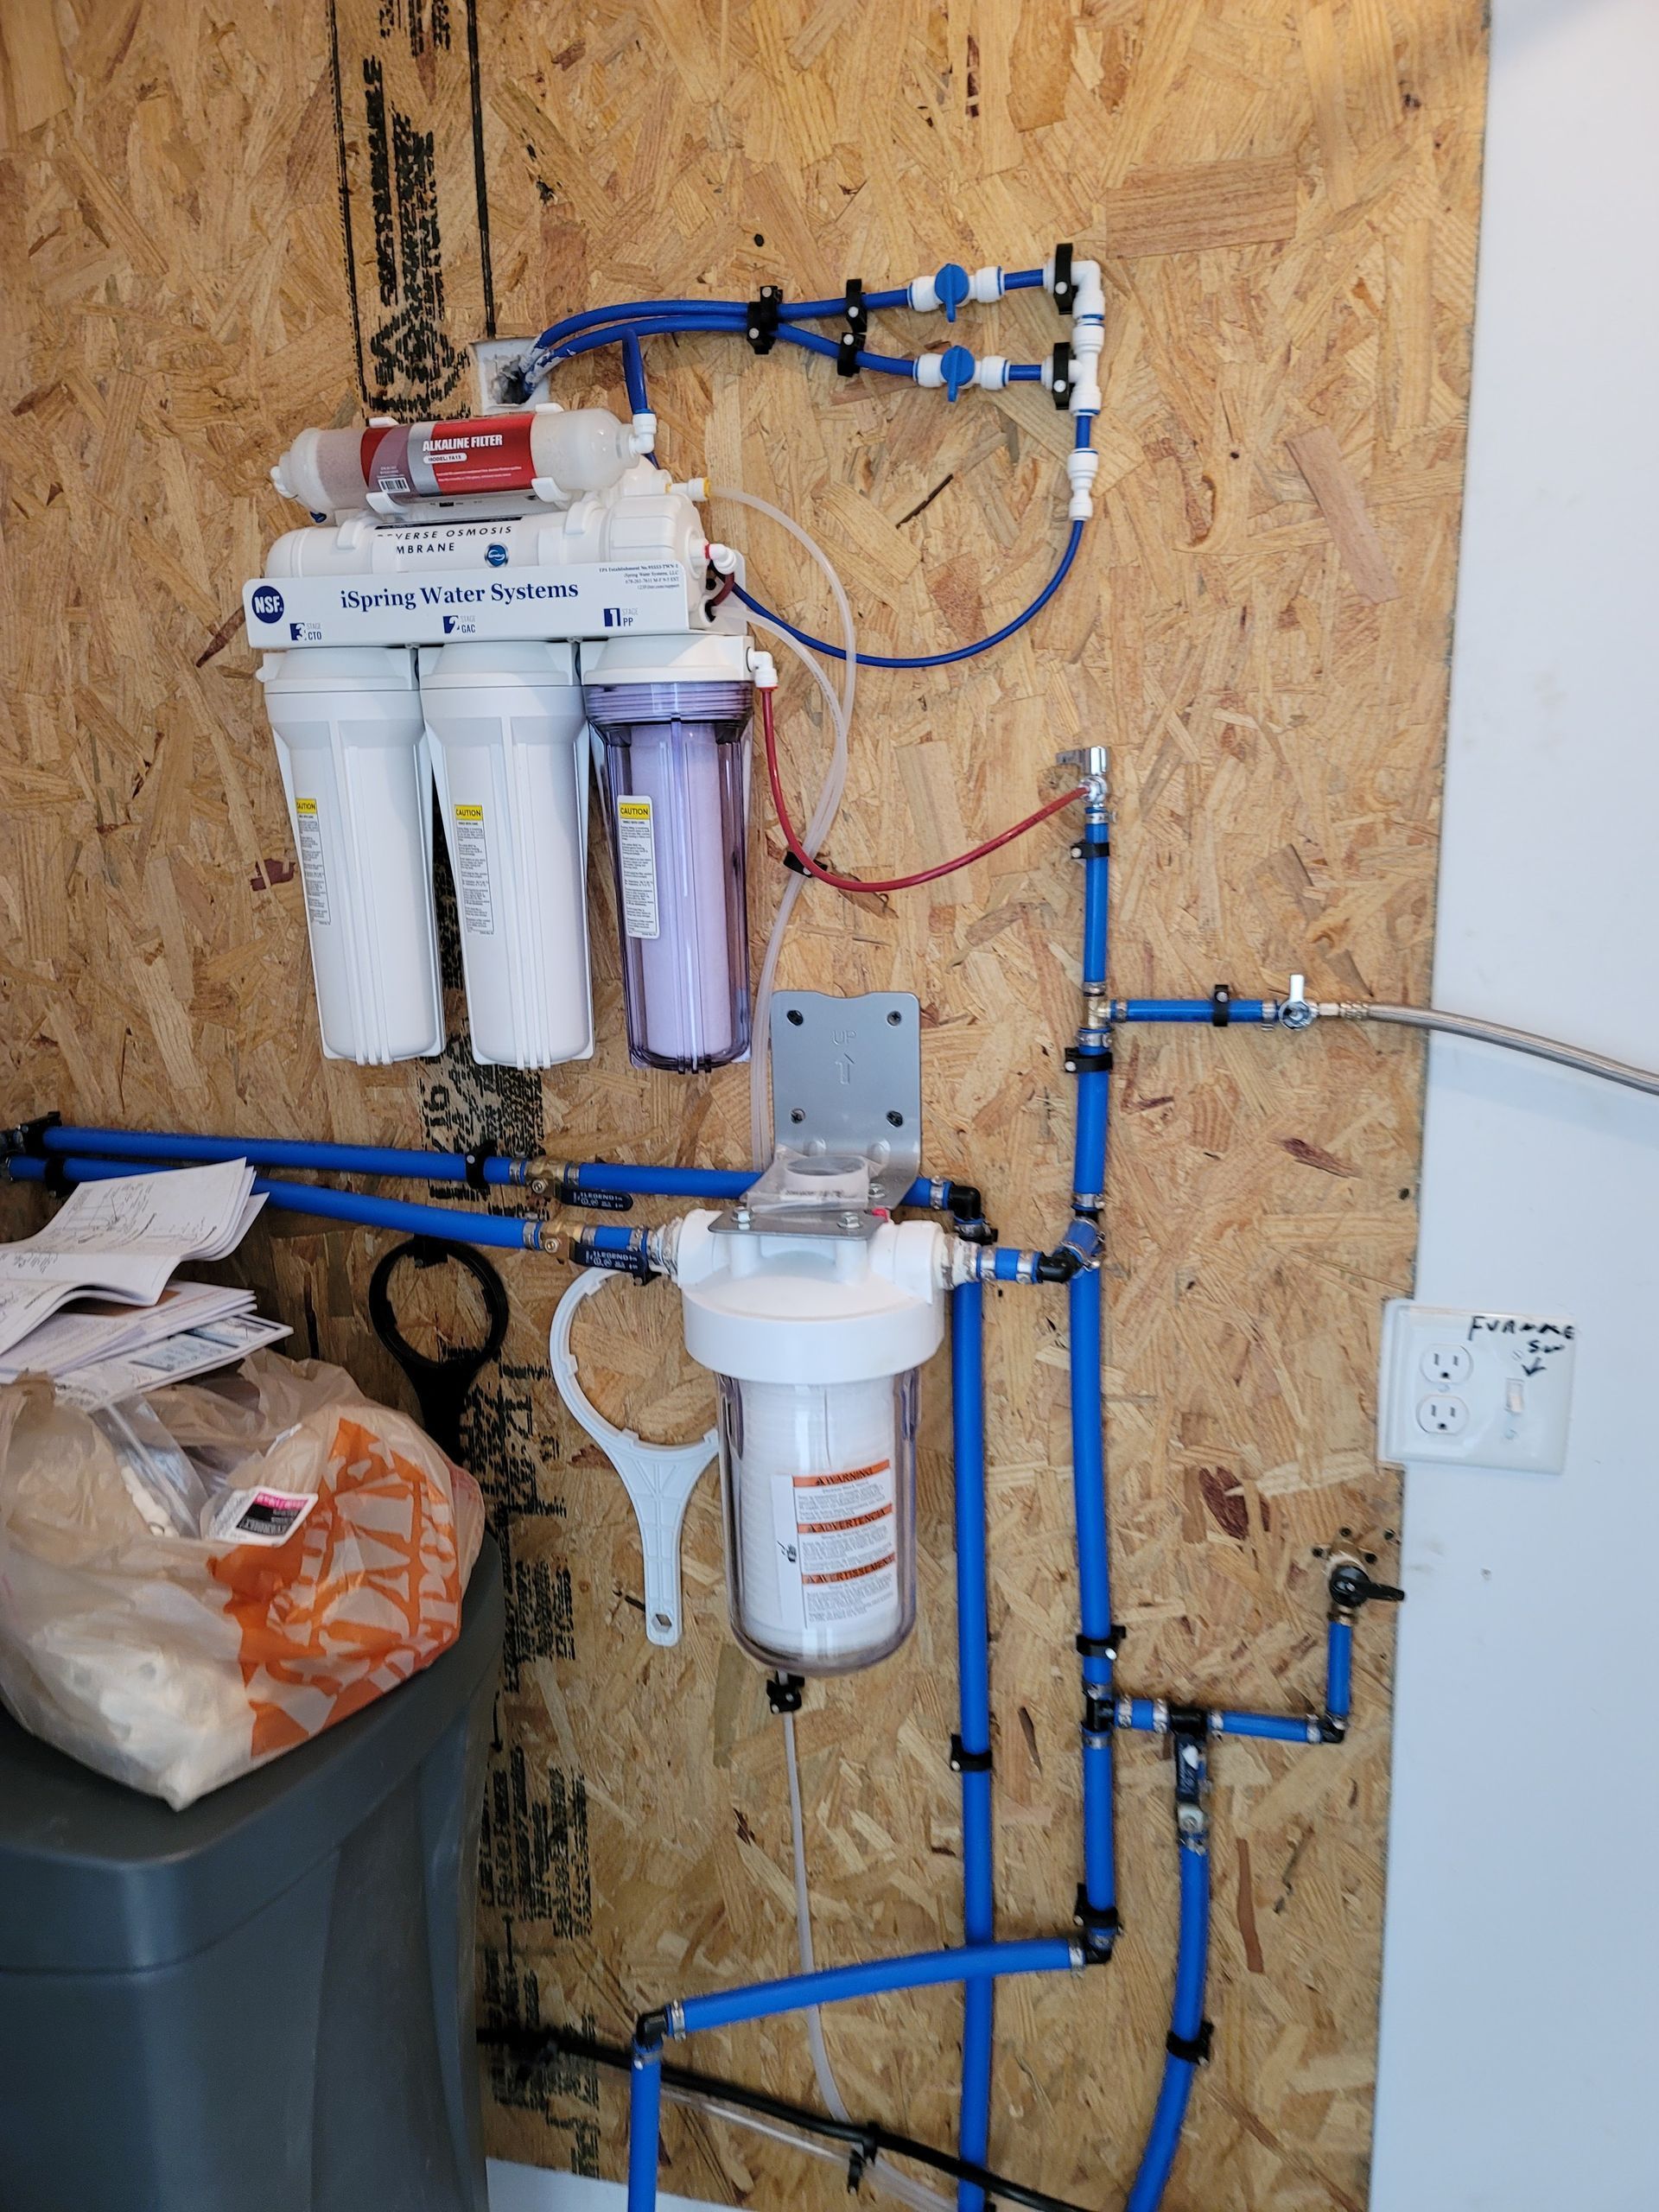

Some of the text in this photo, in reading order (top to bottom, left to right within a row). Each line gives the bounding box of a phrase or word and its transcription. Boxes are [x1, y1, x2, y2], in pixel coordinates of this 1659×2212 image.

[423, 434, 503, 452] ALKALINE FILTER
[378, 525, 512, 540] VERSE OSMOSIS
[397, 543, 454, 555] MBRANE
[340, 582, 579, 613] iSpring Water Systems
[623, 617, 633, 627] PP
[461, 624, 476, 633] GAC
[308, 631, 322, 640] CTO
[455, 808, 481, 817] CAUTION
[620, 807, 649, 816] CAUTION
